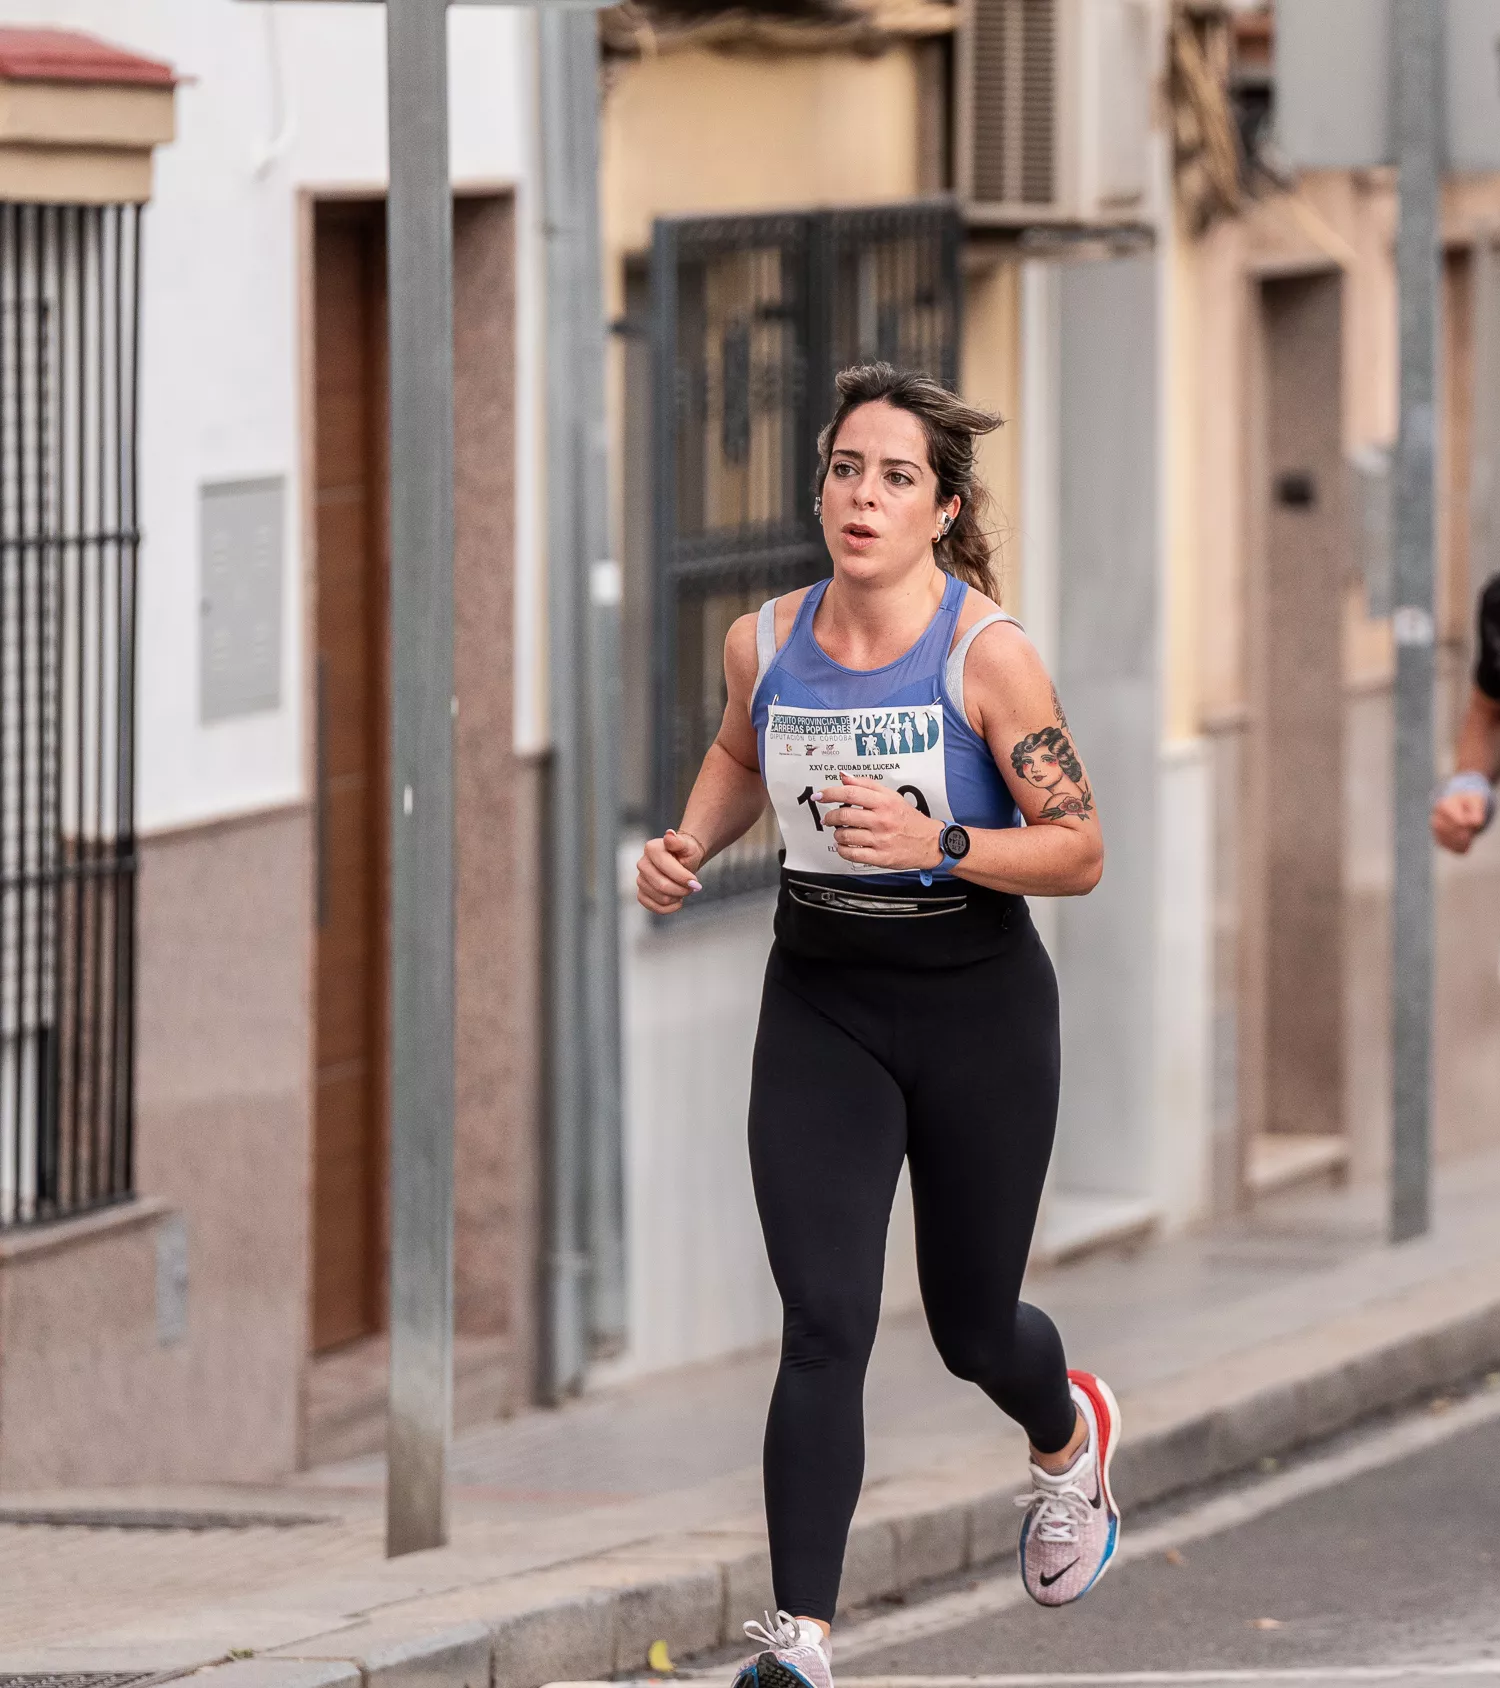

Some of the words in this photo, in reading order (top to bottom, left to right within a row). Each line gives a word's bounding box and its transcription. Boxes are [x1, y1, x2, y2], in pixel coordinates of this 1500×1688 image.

[797, 716, 839, 726] PROVINCIAL
[840, 716, 850, 725] DE
[852, 712, 902, 735] 2024
[771, 723, 804, 734] CARRERAS
[805, 724, 852, 734] POPULARES
[808, 734, 816, 742] DE
